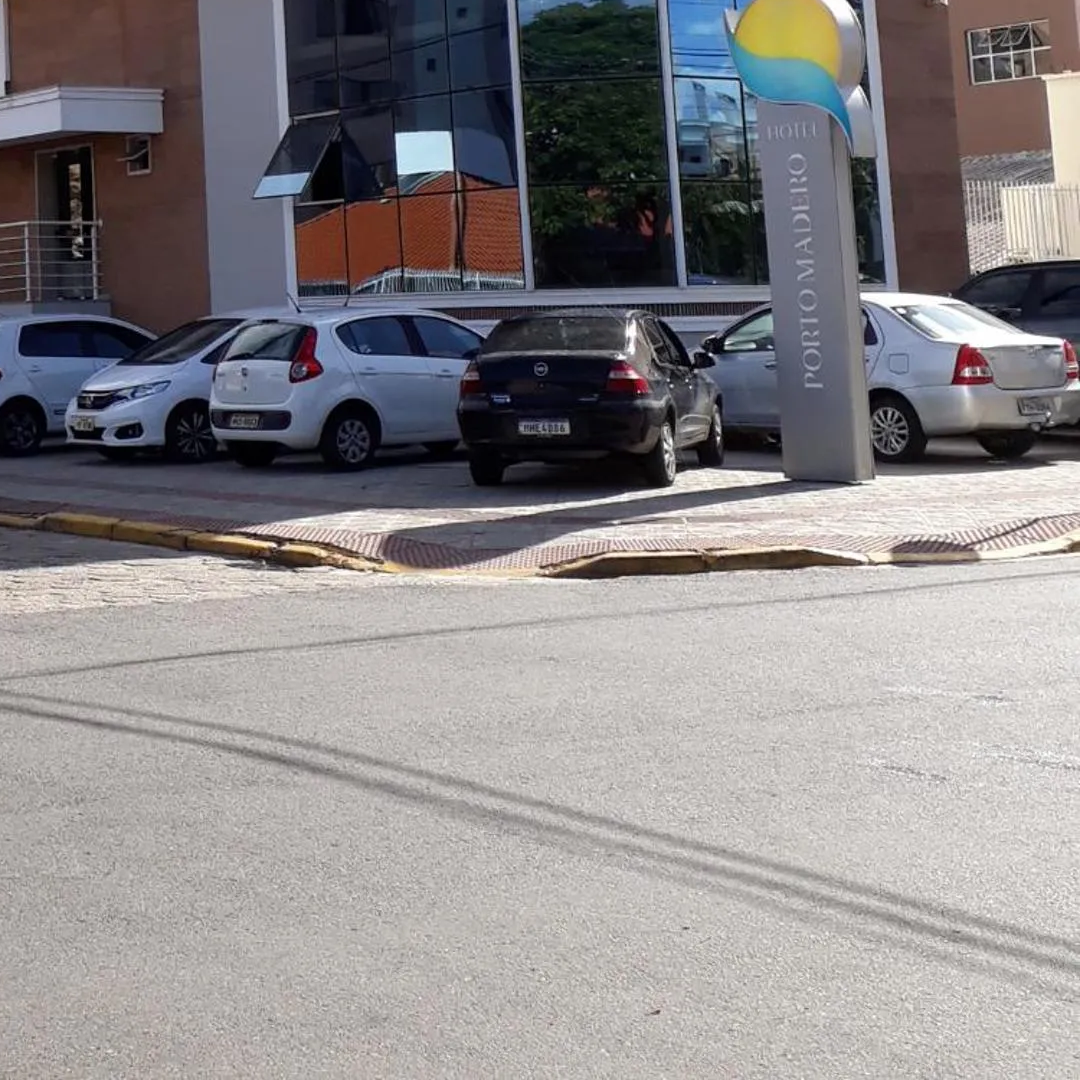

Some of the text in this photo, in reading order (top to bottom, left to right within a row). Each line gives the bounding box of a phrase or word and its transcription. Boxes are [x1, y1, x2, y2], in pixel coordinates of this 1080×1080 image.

[766, 120, 818, 141] HOTEL
[787, 153, 823, 388] PORTO MADERO
